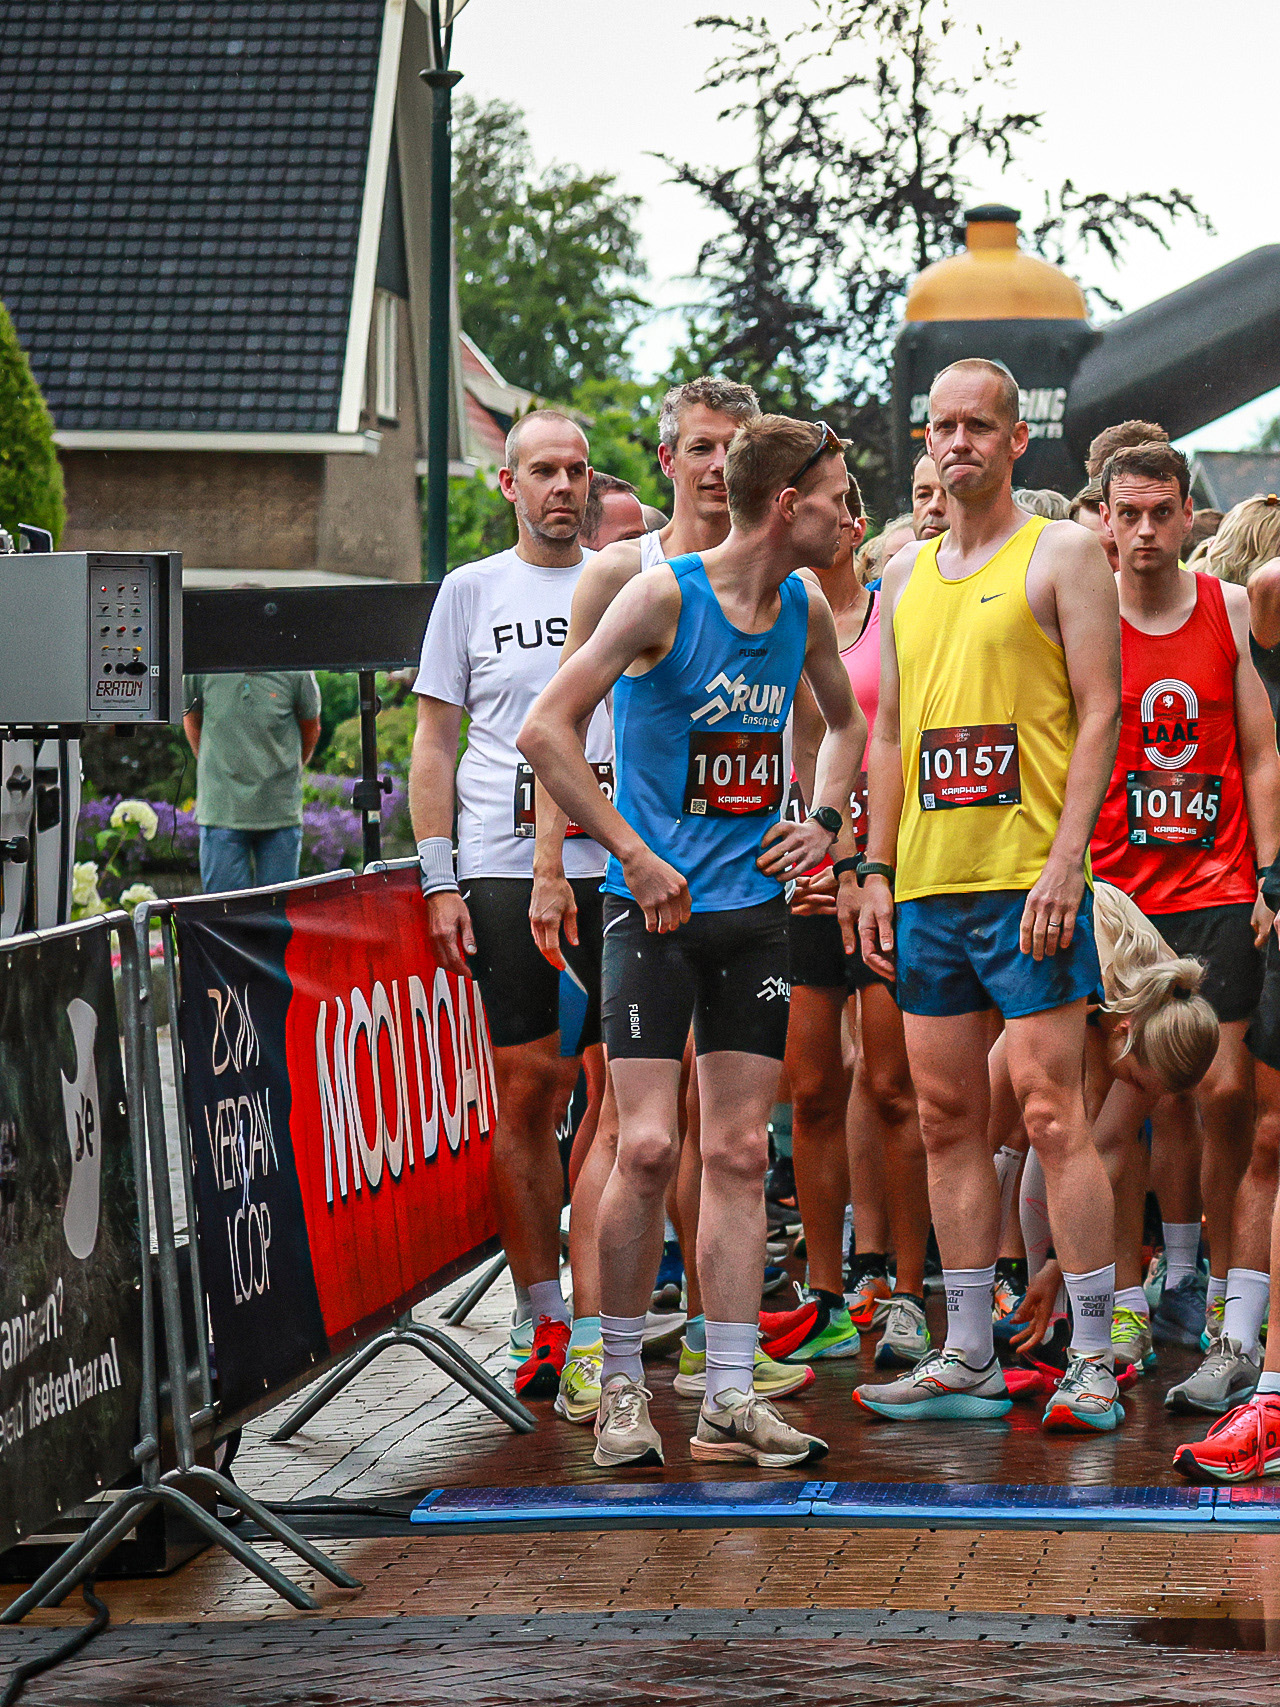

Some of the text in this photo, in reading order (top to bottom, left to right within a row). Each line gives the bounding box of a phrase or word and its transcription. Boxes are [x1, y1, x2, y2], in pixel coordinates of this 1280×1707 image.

[739, 648, 768, 657] FUSION
[96, 680, 143, 697] ERATON
[731, 684, 787, 715] RUN
[743, 714, 780, 728] Ensche
[694, 753, 780, 787] 10141
[921, 744, 1015, 781] 10157
[717, 795, 762, 804] KAMPHUIS
[941, 785, 988, 796] KAMPHUIS
[1131, 789, 1219, 822] 10145
[1153, 826, 1197, 835] KAMPHUIS
[628, 1003, 642, 1039] FUSION
[315, 978, 415, 1204] MOOI
